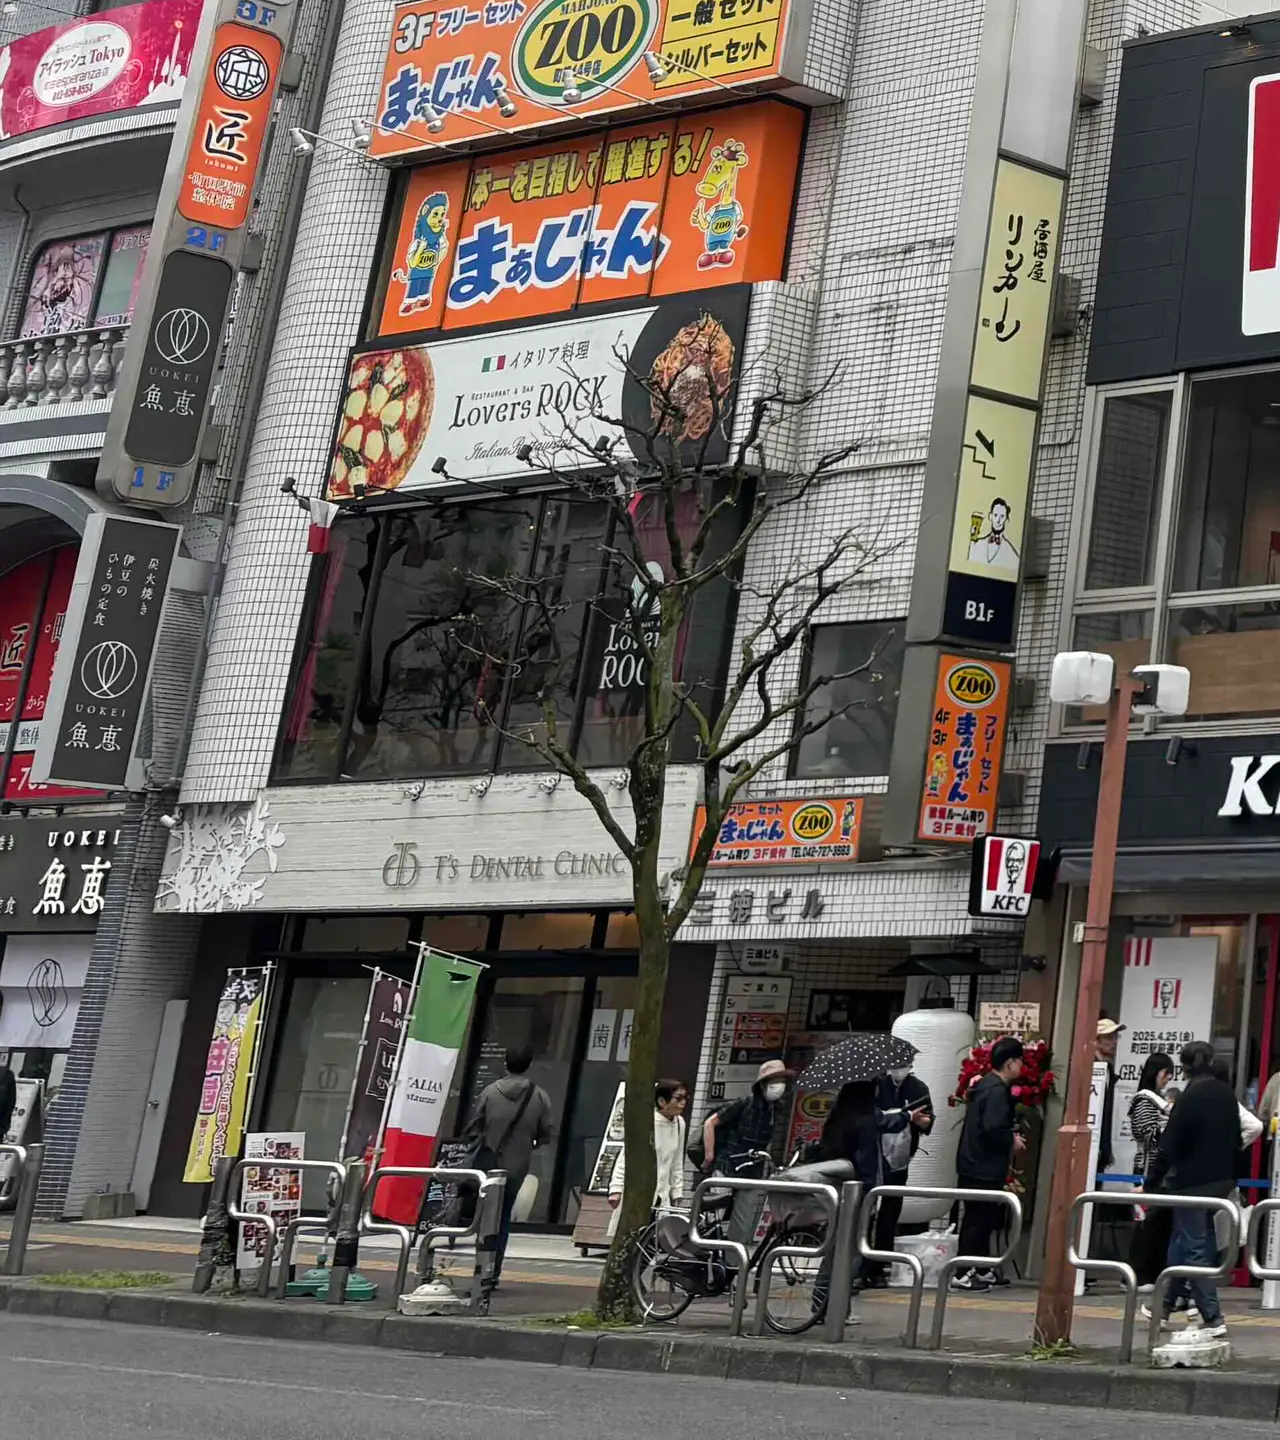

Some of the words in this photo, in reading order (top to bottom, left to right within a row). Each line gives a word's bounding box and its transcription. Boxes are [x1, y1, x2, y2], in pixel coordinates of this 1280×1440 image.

[236, 0, 278, 27] 3F
[395, 14, 432, 54] 3F
[438, 11, 480, 35] フリー
[534, 5, 638, 72] ZOO
[89, 46, 125, 64] Tokyo
[660, 37, 768, 78] シルバーセット
[382, 57, 505, 129] まぁじゃん
[204, 110, 247, 162] 匠
[464, 127, 713, 213] 本一を目指して躍進する!
[186, 226, 228, 251] 2F
[1027, 219, 1051, 285] 居酒屋
[448, 206, 666, 305] まぁじゃん
[993, 214, 1023, 342] リンカーン
[509, 340, 591, 370] イタリア料理
[149, 366, 200, 383] UOKEI
[140, 383, 196, 416] 魚恵
[449, 394, 531, 428] Lovers
[536, 376, 607, 417] ROCK
[465, 441, 508, 461] Italian
[131, 467, 175, 491] 1F
[93, 555, 119, 627] ひもの定食
[116, 554, 135, 597] 伊豆の
[965, 599, 994, 623] B1F
[956, 674, 992, 695] ZOO
[75, 703, 126, 717] UOKEI
[935, 708, 950, 724] 4F
[64, 721, 122, 752] 魚恵
[932, 730, 947, 746] 3F
[985, 715, 997, 751] フリー
[947, 713, 977, 802] まぁじゃん
[978, 757, 992, 793] セット
[759, 804, 782, 815] セット
[798, 813, 831, 830] ZOO
[48, 829, 121, 847] UOKEI
[720, 817, 784, 844] まぁじゃん
[470, 852, 543, 880] DENTAL
[554, 849, 627, 877] CLINIC
[32, 856, 112, 914] 魚恵
[991, 894, 1025, 911] KFC
[1132, 1031, 1177, 1042] 2025.4.25
[1179, 1031, 1194, 1042] (金)
